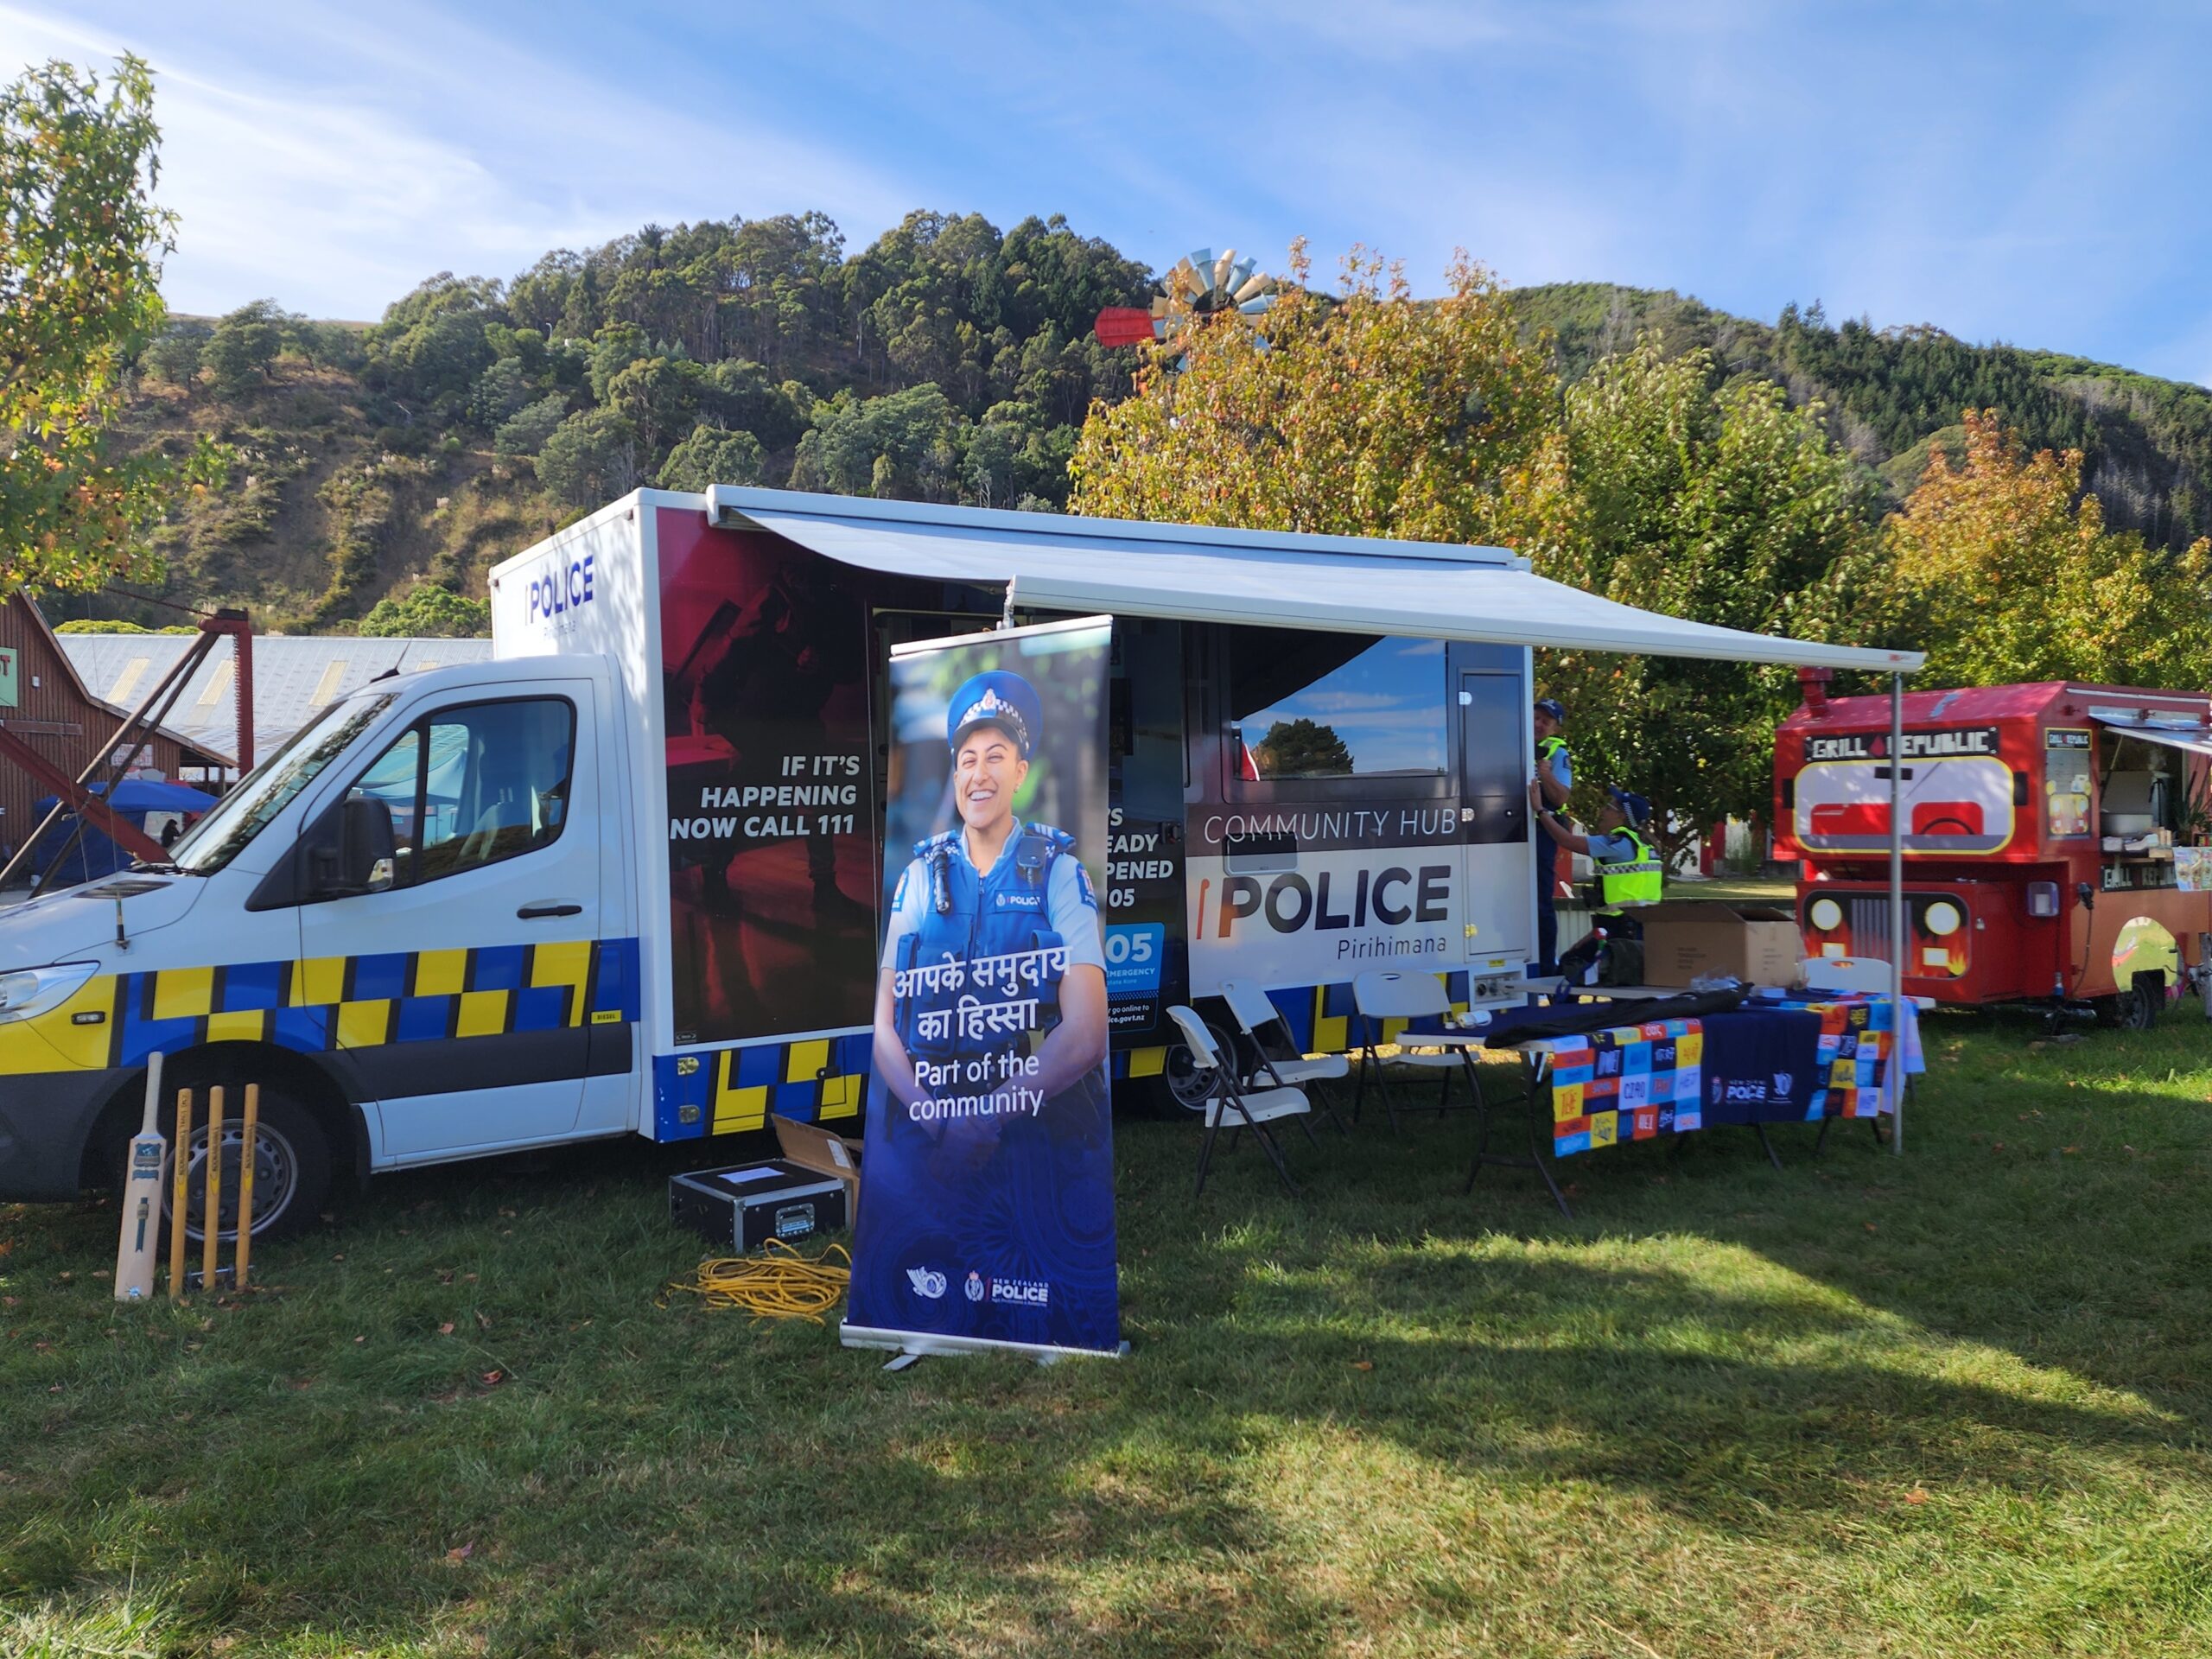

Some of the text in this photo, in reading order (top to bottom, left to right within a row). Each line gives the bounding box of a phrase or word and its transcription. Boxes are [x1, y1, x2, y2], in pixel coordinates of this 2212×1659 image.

[531, 555, 593, 623] POLICE
[1813, 738, 1867, 758] GRILL
[781, 755, 860, 776] IF IT'S
[701, 785, 856, 808] HAPPENING
[670, 814, 854, 839] NOW CALL 111
[1205, 808, 1456, 843] COMMUNITY HUB
[1218, 865, 1451, 938] POLICE
[1338, 936, 1446, 960] Pirihimana
[893, 945, 1073, 998] आपके समुदाय
[918, 995, 1039, 1040] का हिस्सा
[915, 1049, 1039, 1087] Part of the
[909, 1085, 1044, 1122] community
[992, 1284, 1048, 1302] POLICE
[1013, 1279, 1049, 1287] ZEALAND
